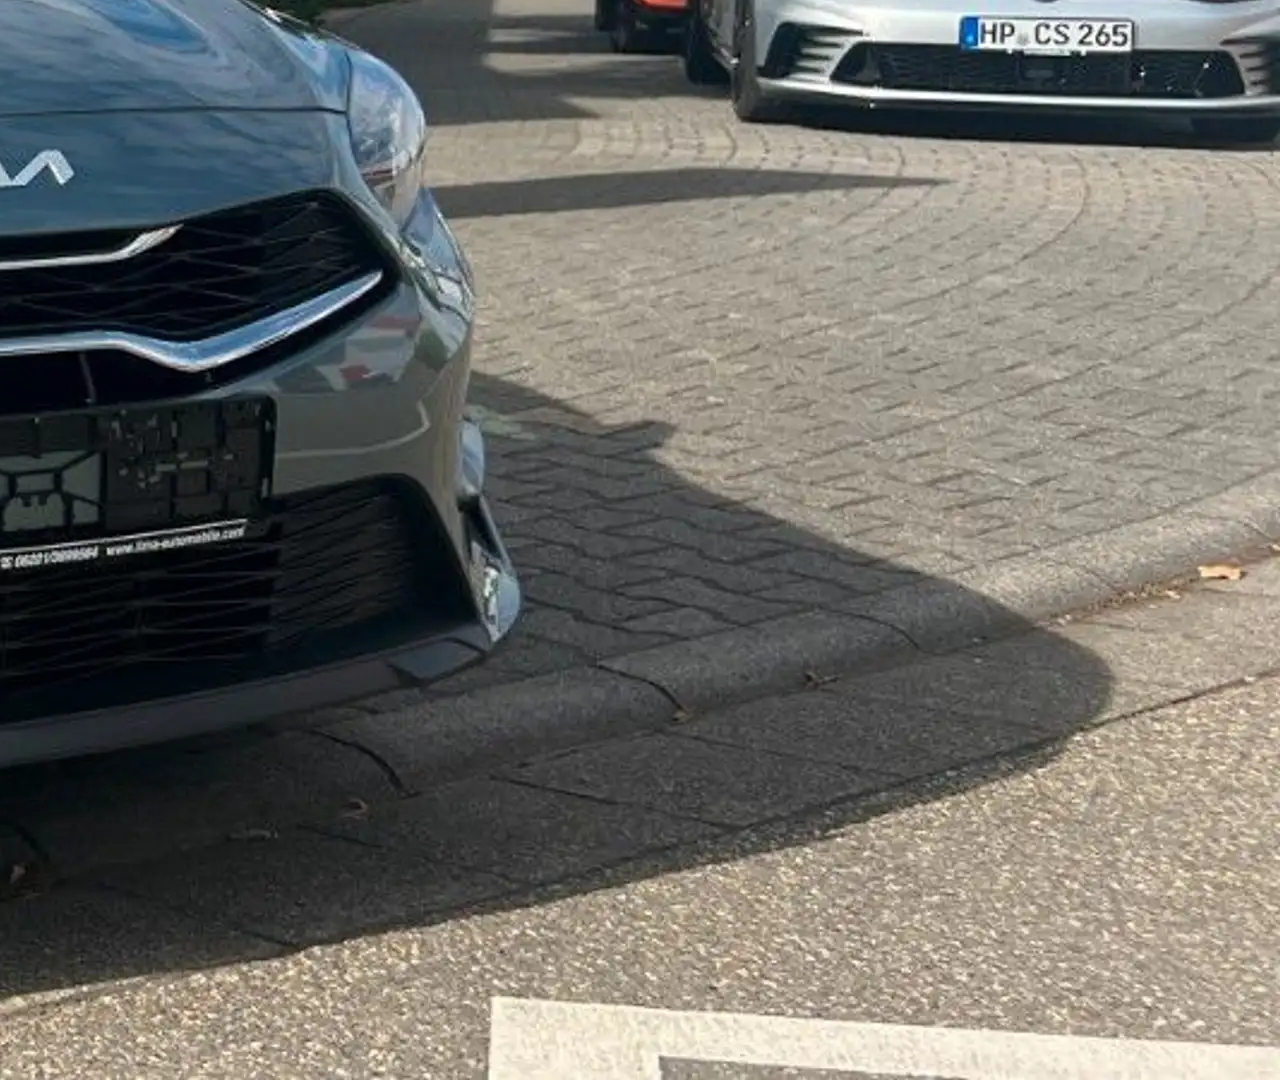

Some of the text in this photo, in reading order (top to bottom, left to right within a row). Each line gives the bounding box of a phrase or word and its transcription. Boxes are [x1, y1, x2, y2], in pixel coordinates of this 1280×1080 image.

[980, 22, 1129, 47] HP CS 265
